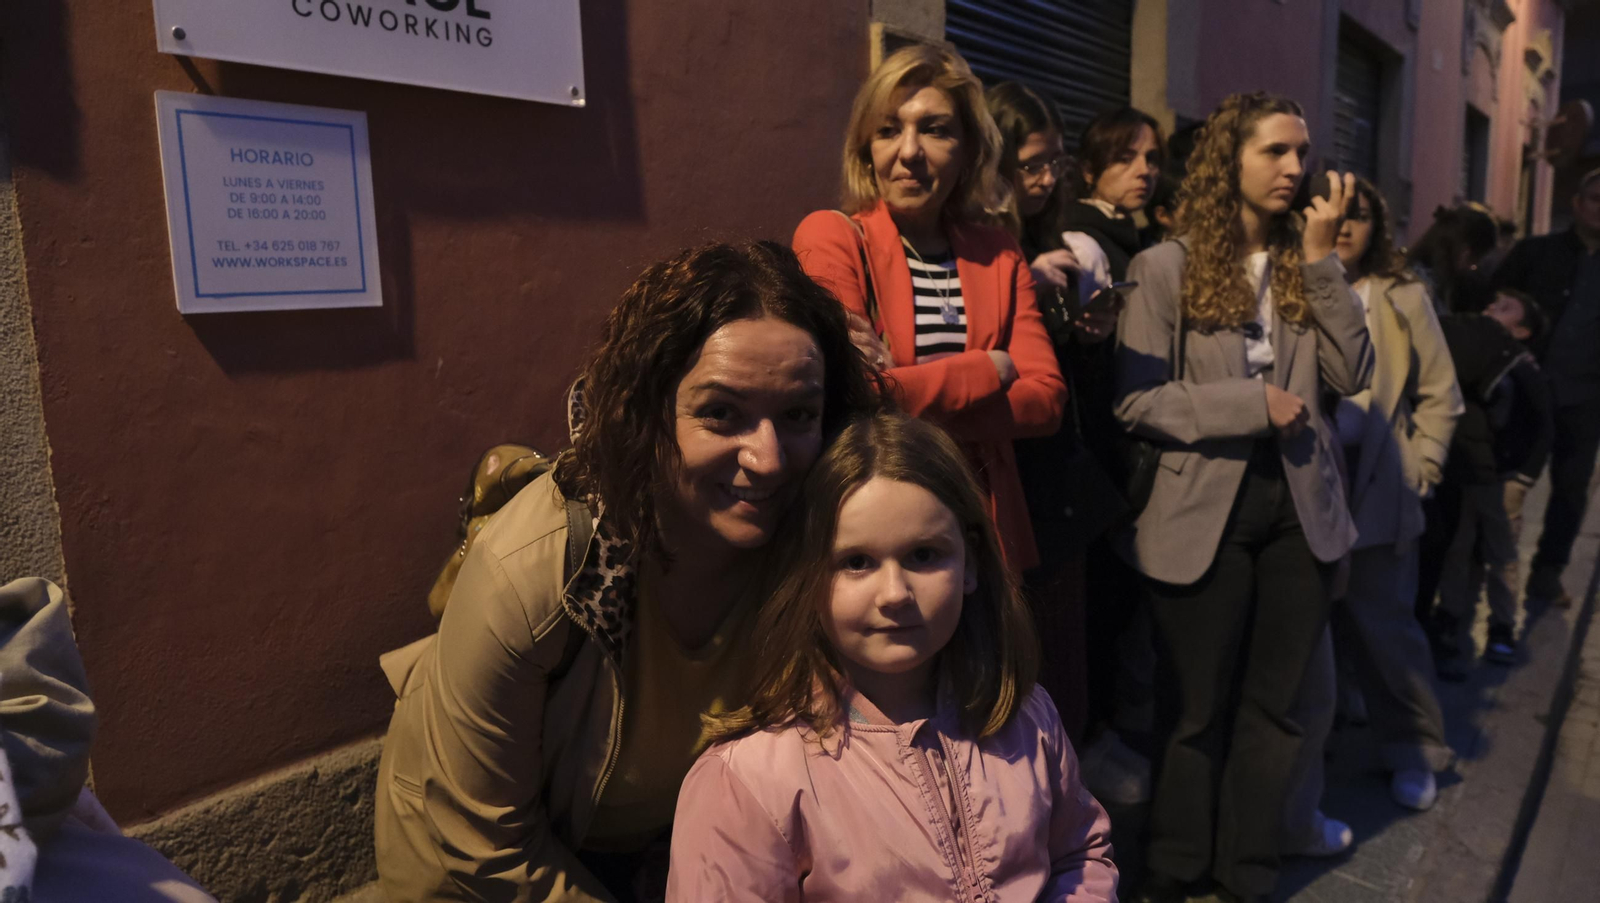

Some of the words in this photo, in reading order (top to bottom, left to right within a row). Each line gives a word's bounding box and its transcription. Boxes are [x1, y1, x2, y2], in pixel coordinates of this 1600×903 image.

[292, 0, 493, 47] COWORKING
[230, 148, 314, 167] HORARIO
[222, 176, 262, 188] LUNES
[265, 178, 274, 188] A
[277, 179, 325, 191] VIERNES
[229, 192, 246, 203] DE
[249, 192, 277, 204] 9:00
[280, 194, 289, 204] A
[292, 194, 321, 206] 14:00
[227, 208, 244, 219] DE
[247, 208, 279, 219] 16:00
[282, 209, 291, 220] A
[294, 209, 326, 221] 20:00
[217, 240, 241, 251] TEL.
[244, 240, 269, 251] +34
[271, 240, 295, 251] 625
[297, 240, 317, 251] 018
[319, 240, 341, 252] 767
[212, 256, 348, 269] WWW.WORKSPACE.ES
